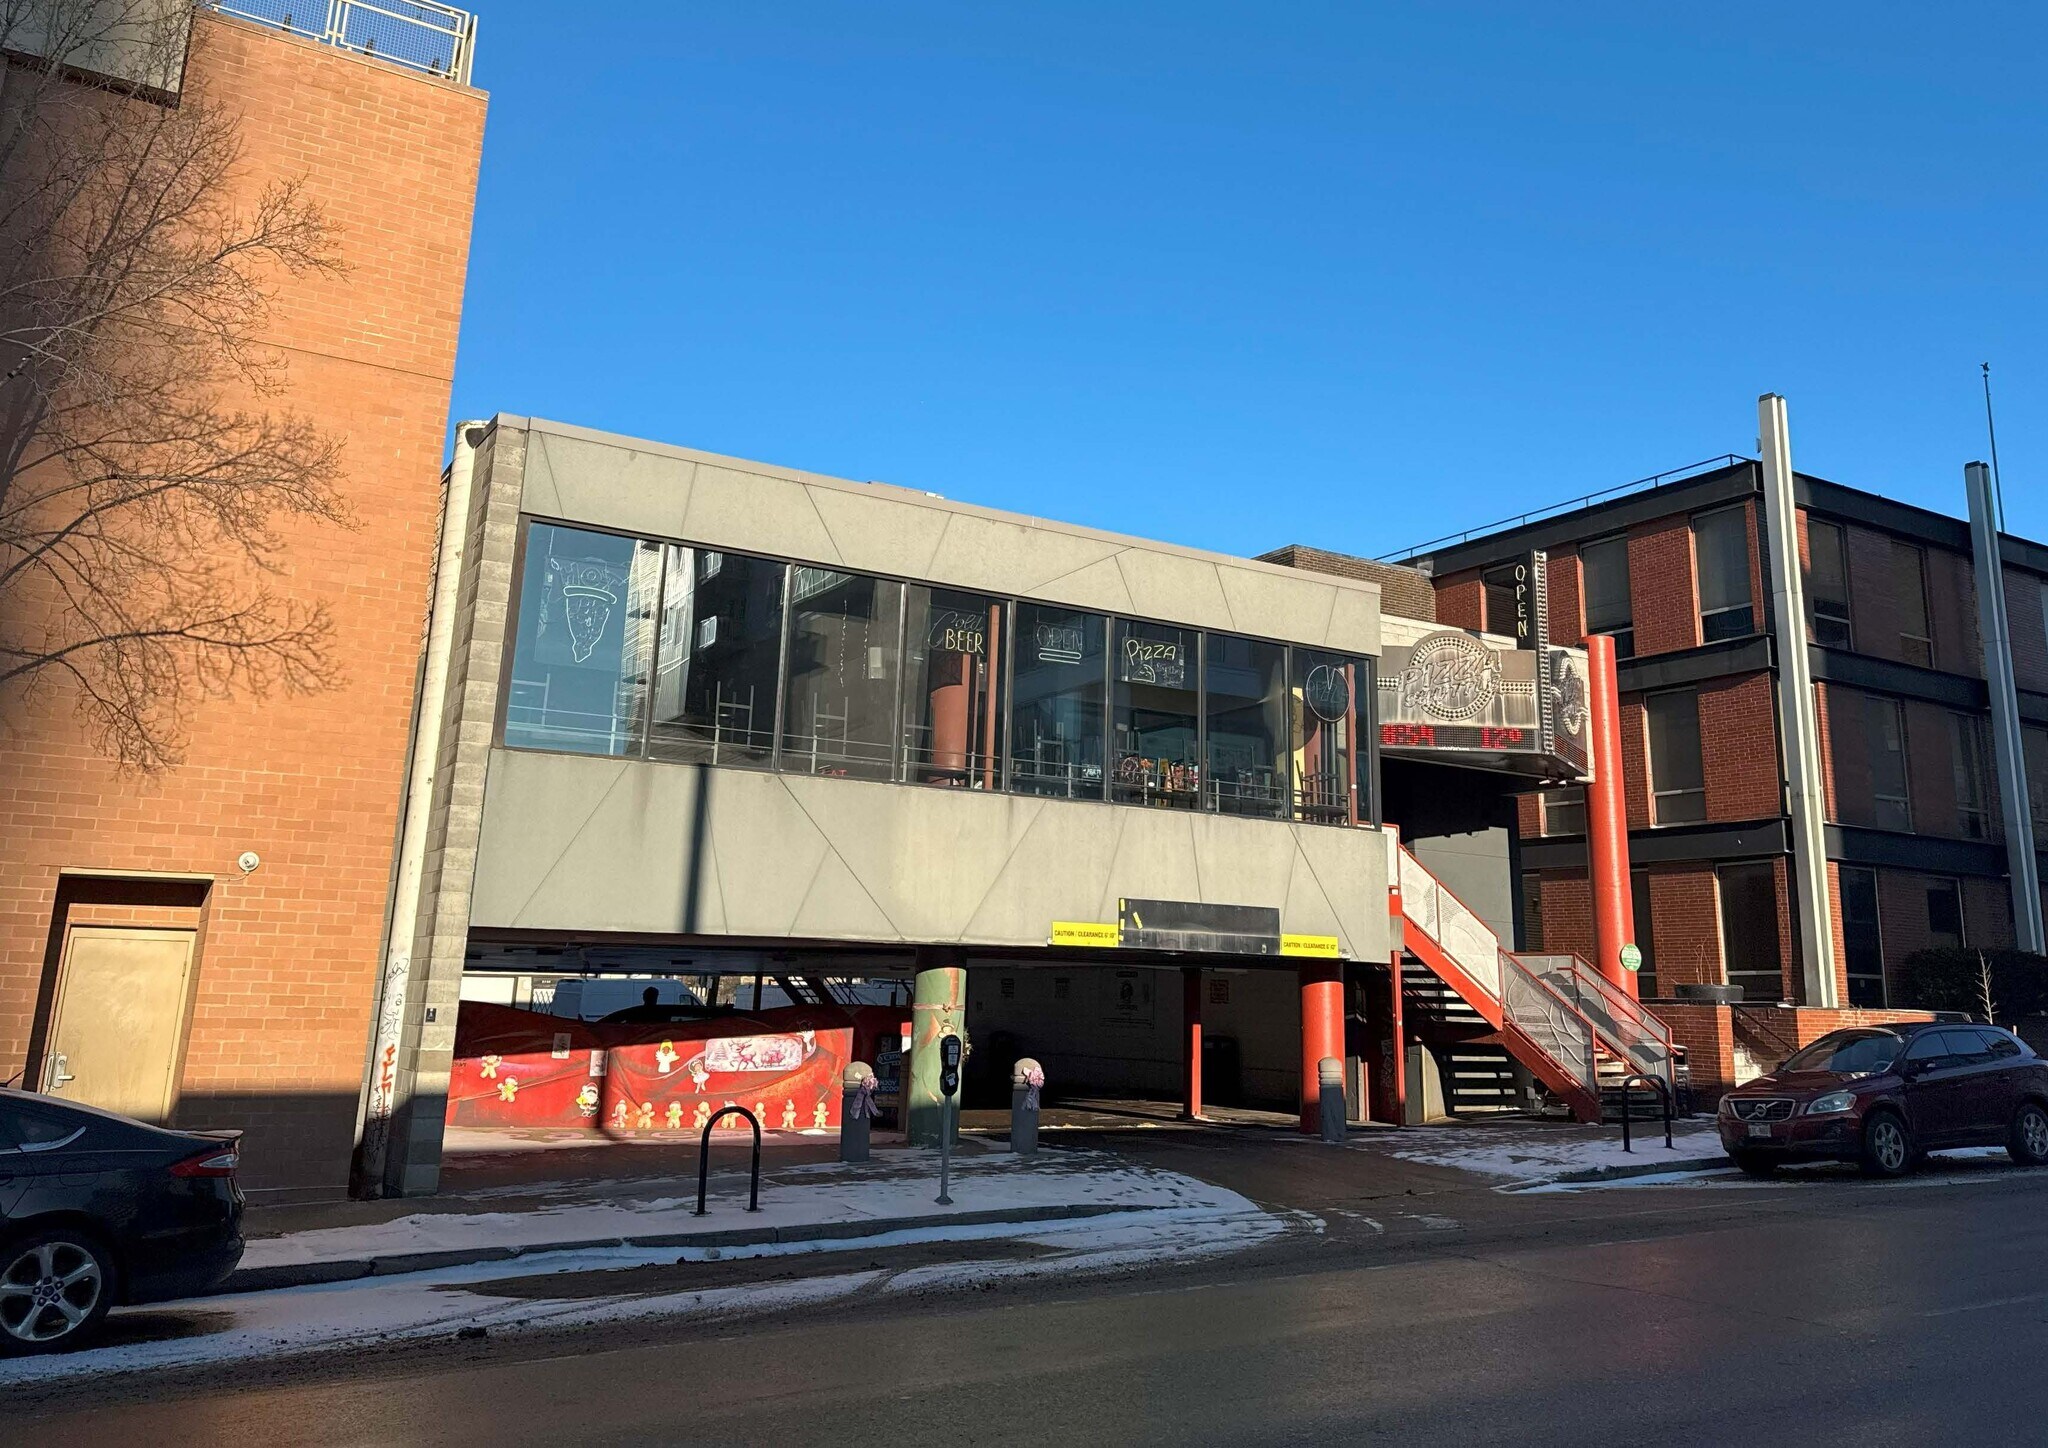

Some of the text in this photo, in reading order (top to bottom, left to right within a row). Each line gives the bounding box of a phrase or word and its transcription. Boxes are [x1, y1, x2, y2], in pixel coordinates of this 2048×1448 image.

[1515, 564, 1529, 639] OPEN
[927, 611, 984, 648] Cold
[946, 628, 985, 655] BEER
[1037, 624, 1083, 652] OPEN
[1396, 649, 1503, 692] PIZZA
[1404, 673, 1502, 708] SHUTTLE
